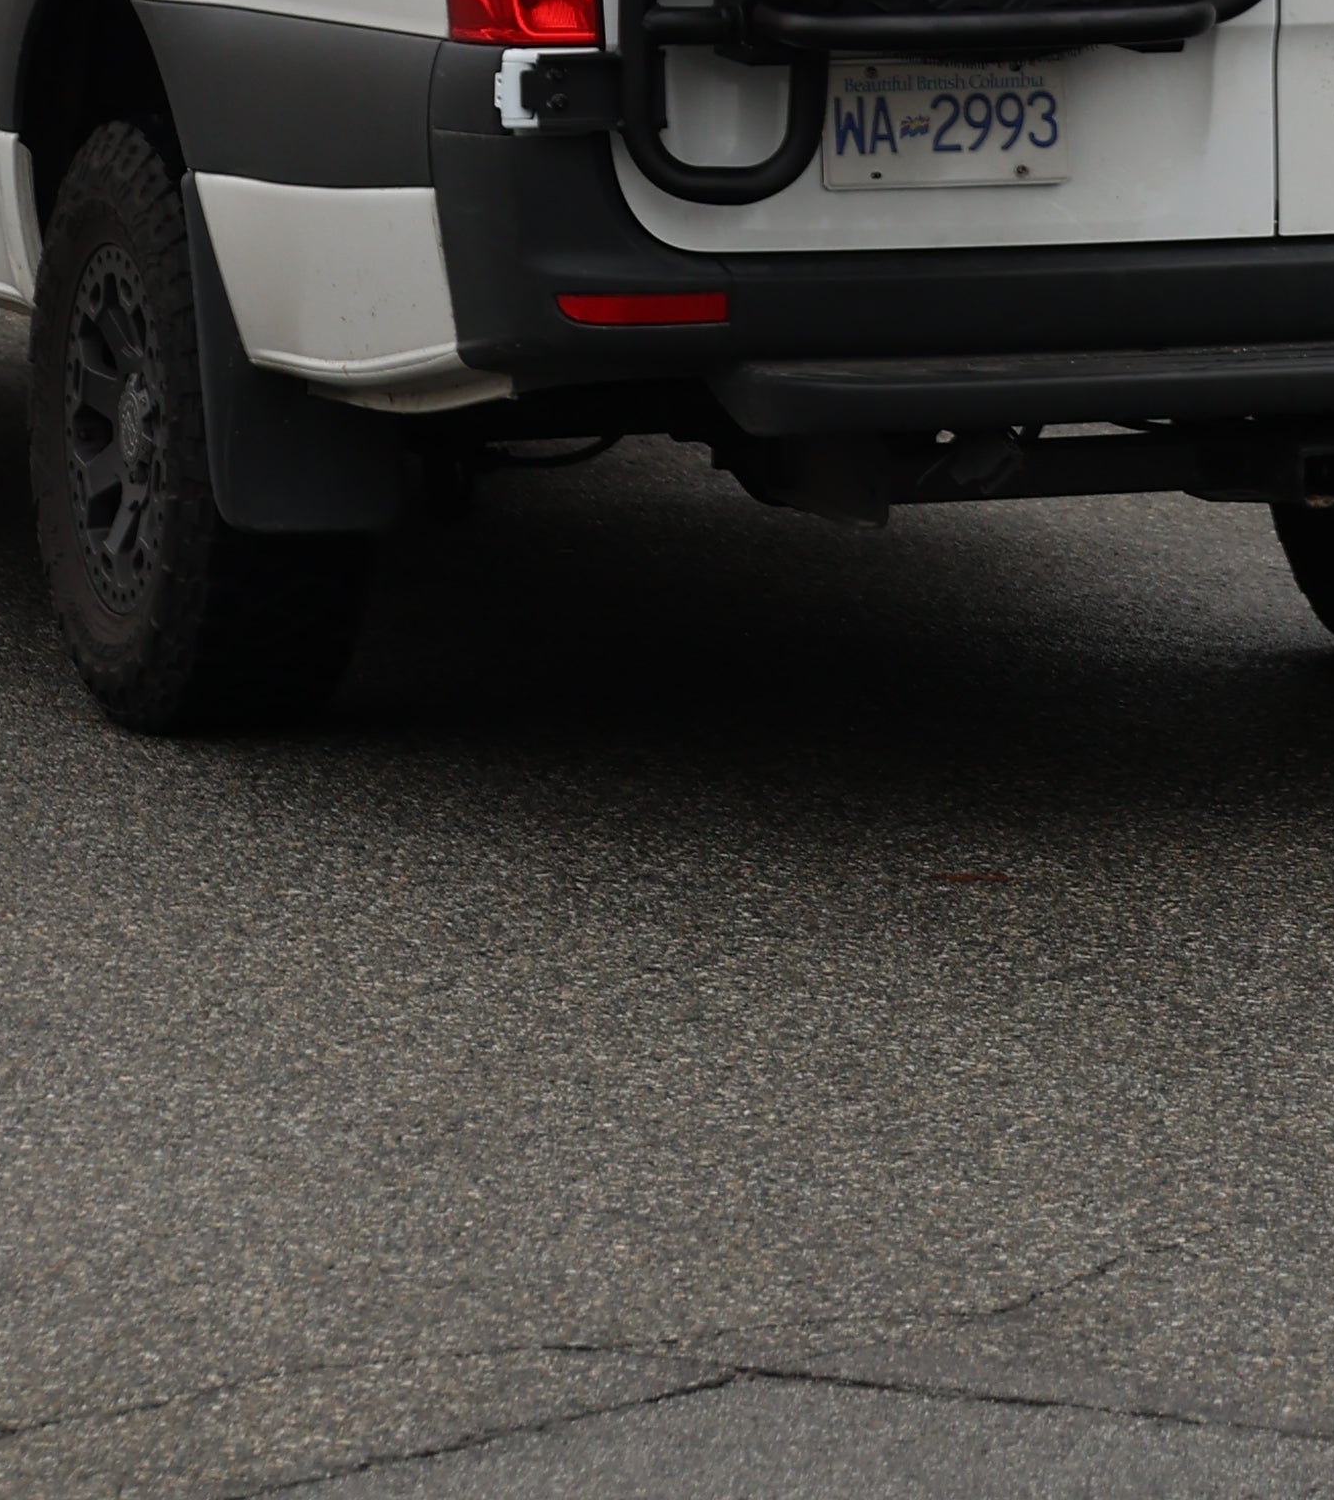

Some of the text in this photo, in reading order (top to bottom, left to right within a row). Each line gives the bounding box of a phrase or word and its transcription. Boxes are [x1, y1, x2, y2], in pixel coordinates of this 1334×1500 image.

[844, 71, 1045, 93] Beautiful British Columbia
